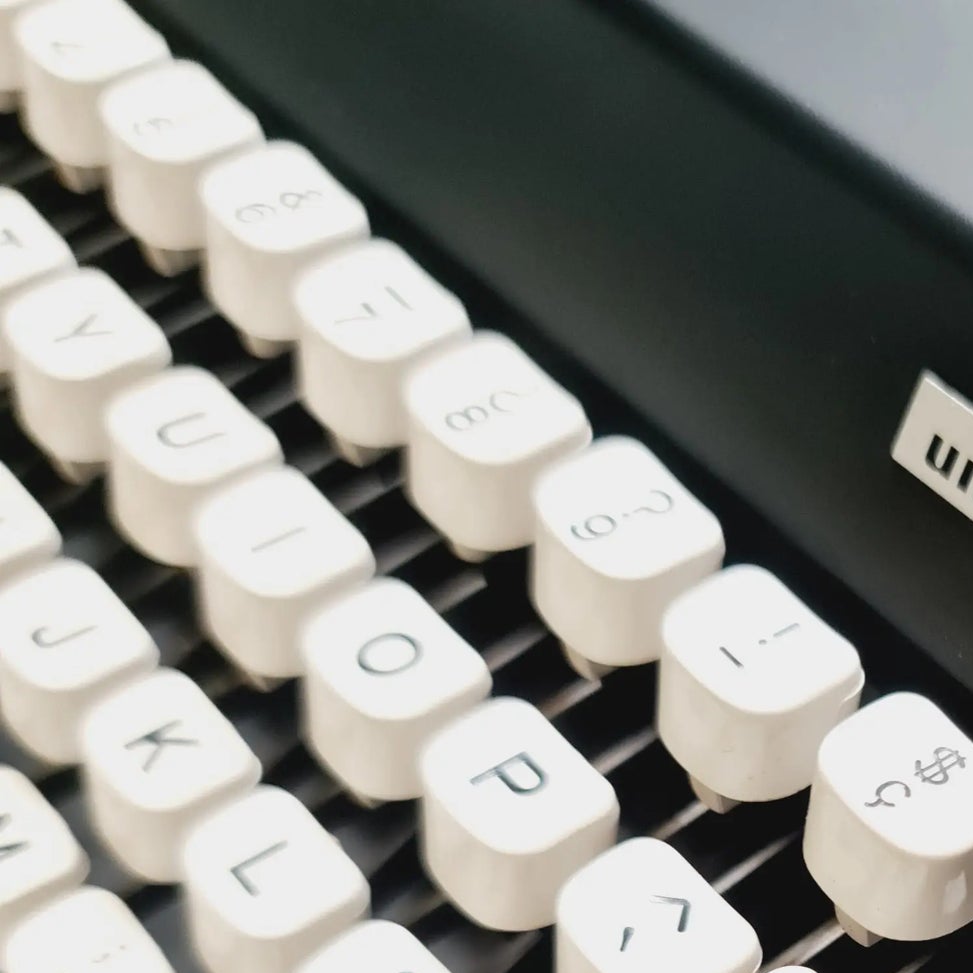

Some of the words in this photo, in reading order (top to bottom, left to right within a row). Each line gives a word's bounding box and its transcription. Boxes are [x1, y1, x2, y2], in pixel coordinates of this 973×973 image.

[234, 202, 277, 224] 6
[278, 189, 323, 211] &
[335, 301, 379, 324] 7
[53, 313, 113, 343] Y
[155, 411, 226, 450] U
[444, 405, 489, 431] 8
[621, 489, 675, 518] ?
[569, 513, 619, 542] 9
[29, 625, 98, 649] J
[757, 622, 801, 646] !
[356, 632, 424, 677] O
[122, 718, 201, 774] K
[469, 751, 550, 797] P
[915, 746, 967, 786] $
[863, 779, 912, 809] ç
[230, 840, 289, 897] L
